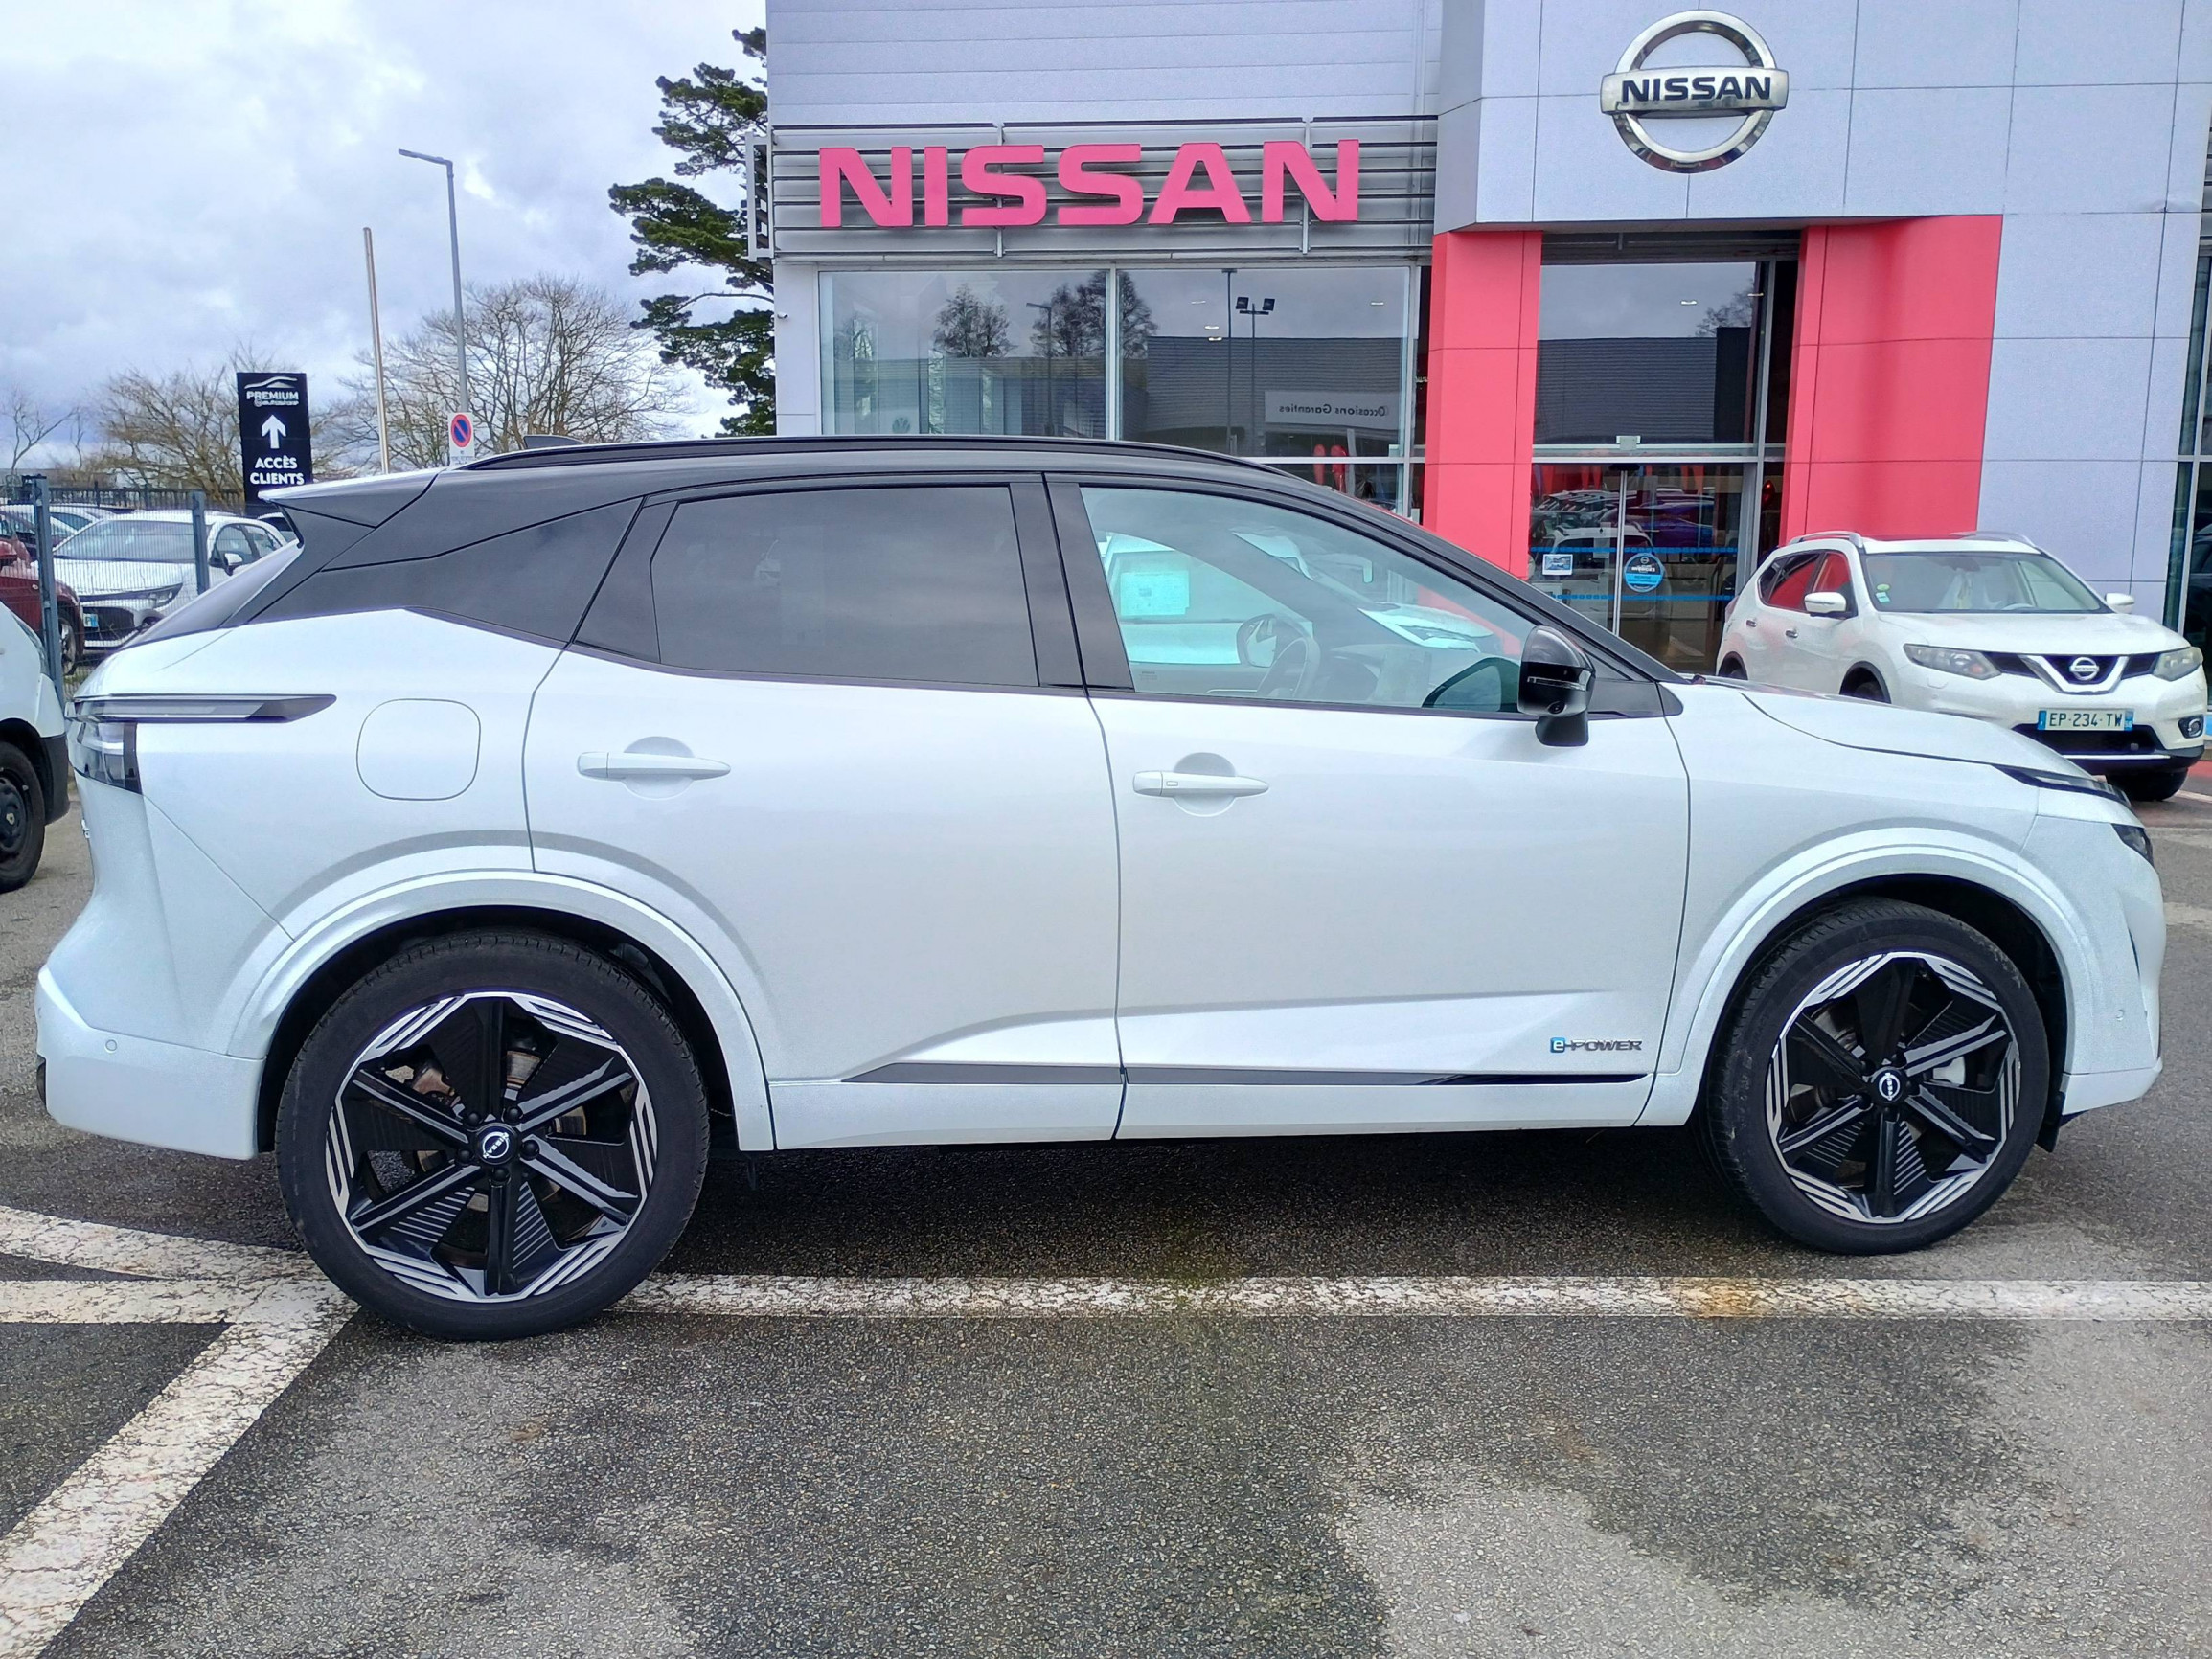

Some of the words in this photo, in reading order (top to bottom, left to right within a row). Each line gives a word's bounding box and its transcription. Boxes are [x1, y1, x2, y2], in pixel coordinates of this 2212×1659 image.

[1622, 76, 1771, 102] NISSAN
[819, 139, 1360, 228] NISSAN
[246, 391, 299, 400] PREMIUM
[254, 455, 298, 469] ACCÈS
[249, 472, 305, 485] CLIENTS
